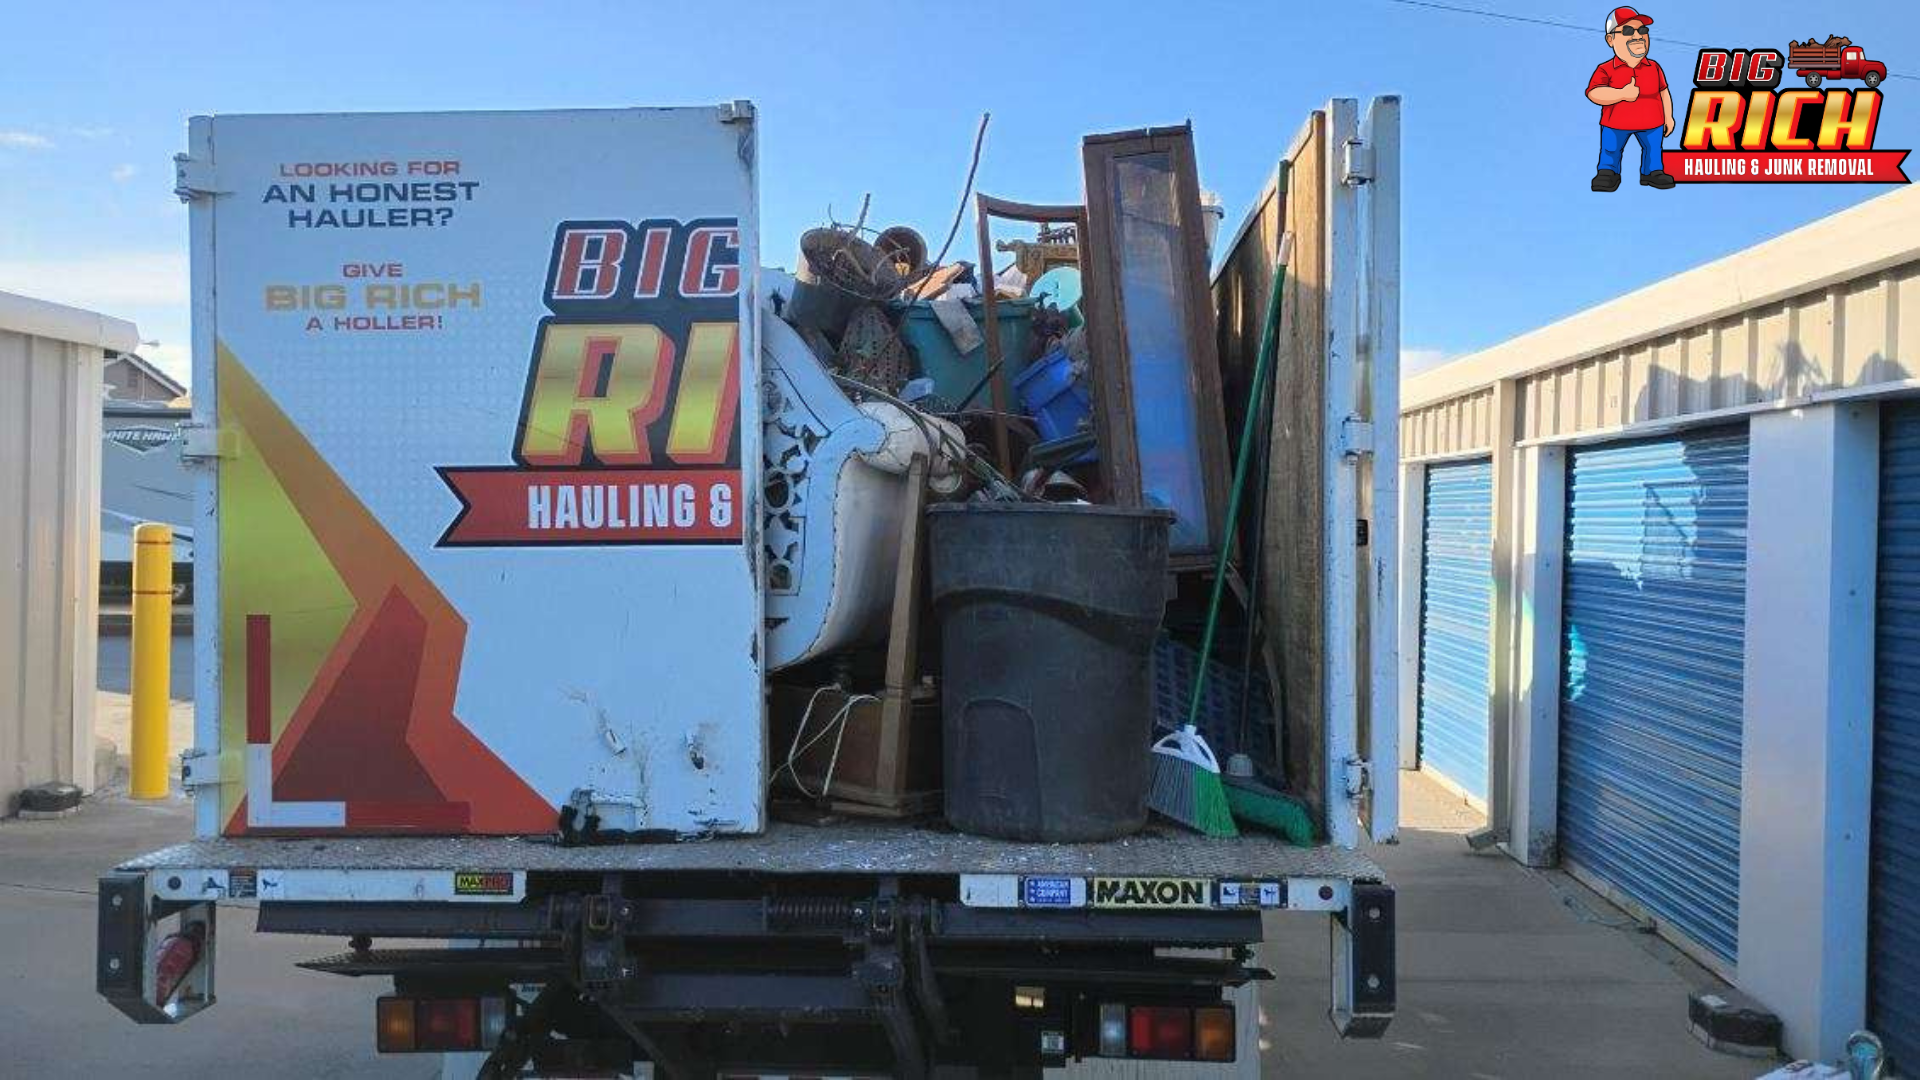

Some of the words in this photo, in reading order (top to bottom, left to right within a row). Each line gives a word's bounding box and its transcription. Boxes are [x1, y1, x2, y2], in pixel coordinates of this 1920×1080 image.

[280, 162, 398, 177] LOOKING
[408, 161, 461, 176] FOR
[263, 184, 315, 203] AN
[330, 182, 480, 203] HONEST
[288, 208, 454, 228] HAULER?
[342, 263, 403, 278] GIVE
[551, 227, 739, 300] BIG
[265, 284, 348, 311] BIG
[365, 282, 481, 309] RICH
[305, 317, 323, 331] A
[334, 315, 443, 331] HOLLER!
[528, 484, 695, 529] HAULING
[709, 484, 732, 528] &
[1097, 881, 1204, 904] MAXON
